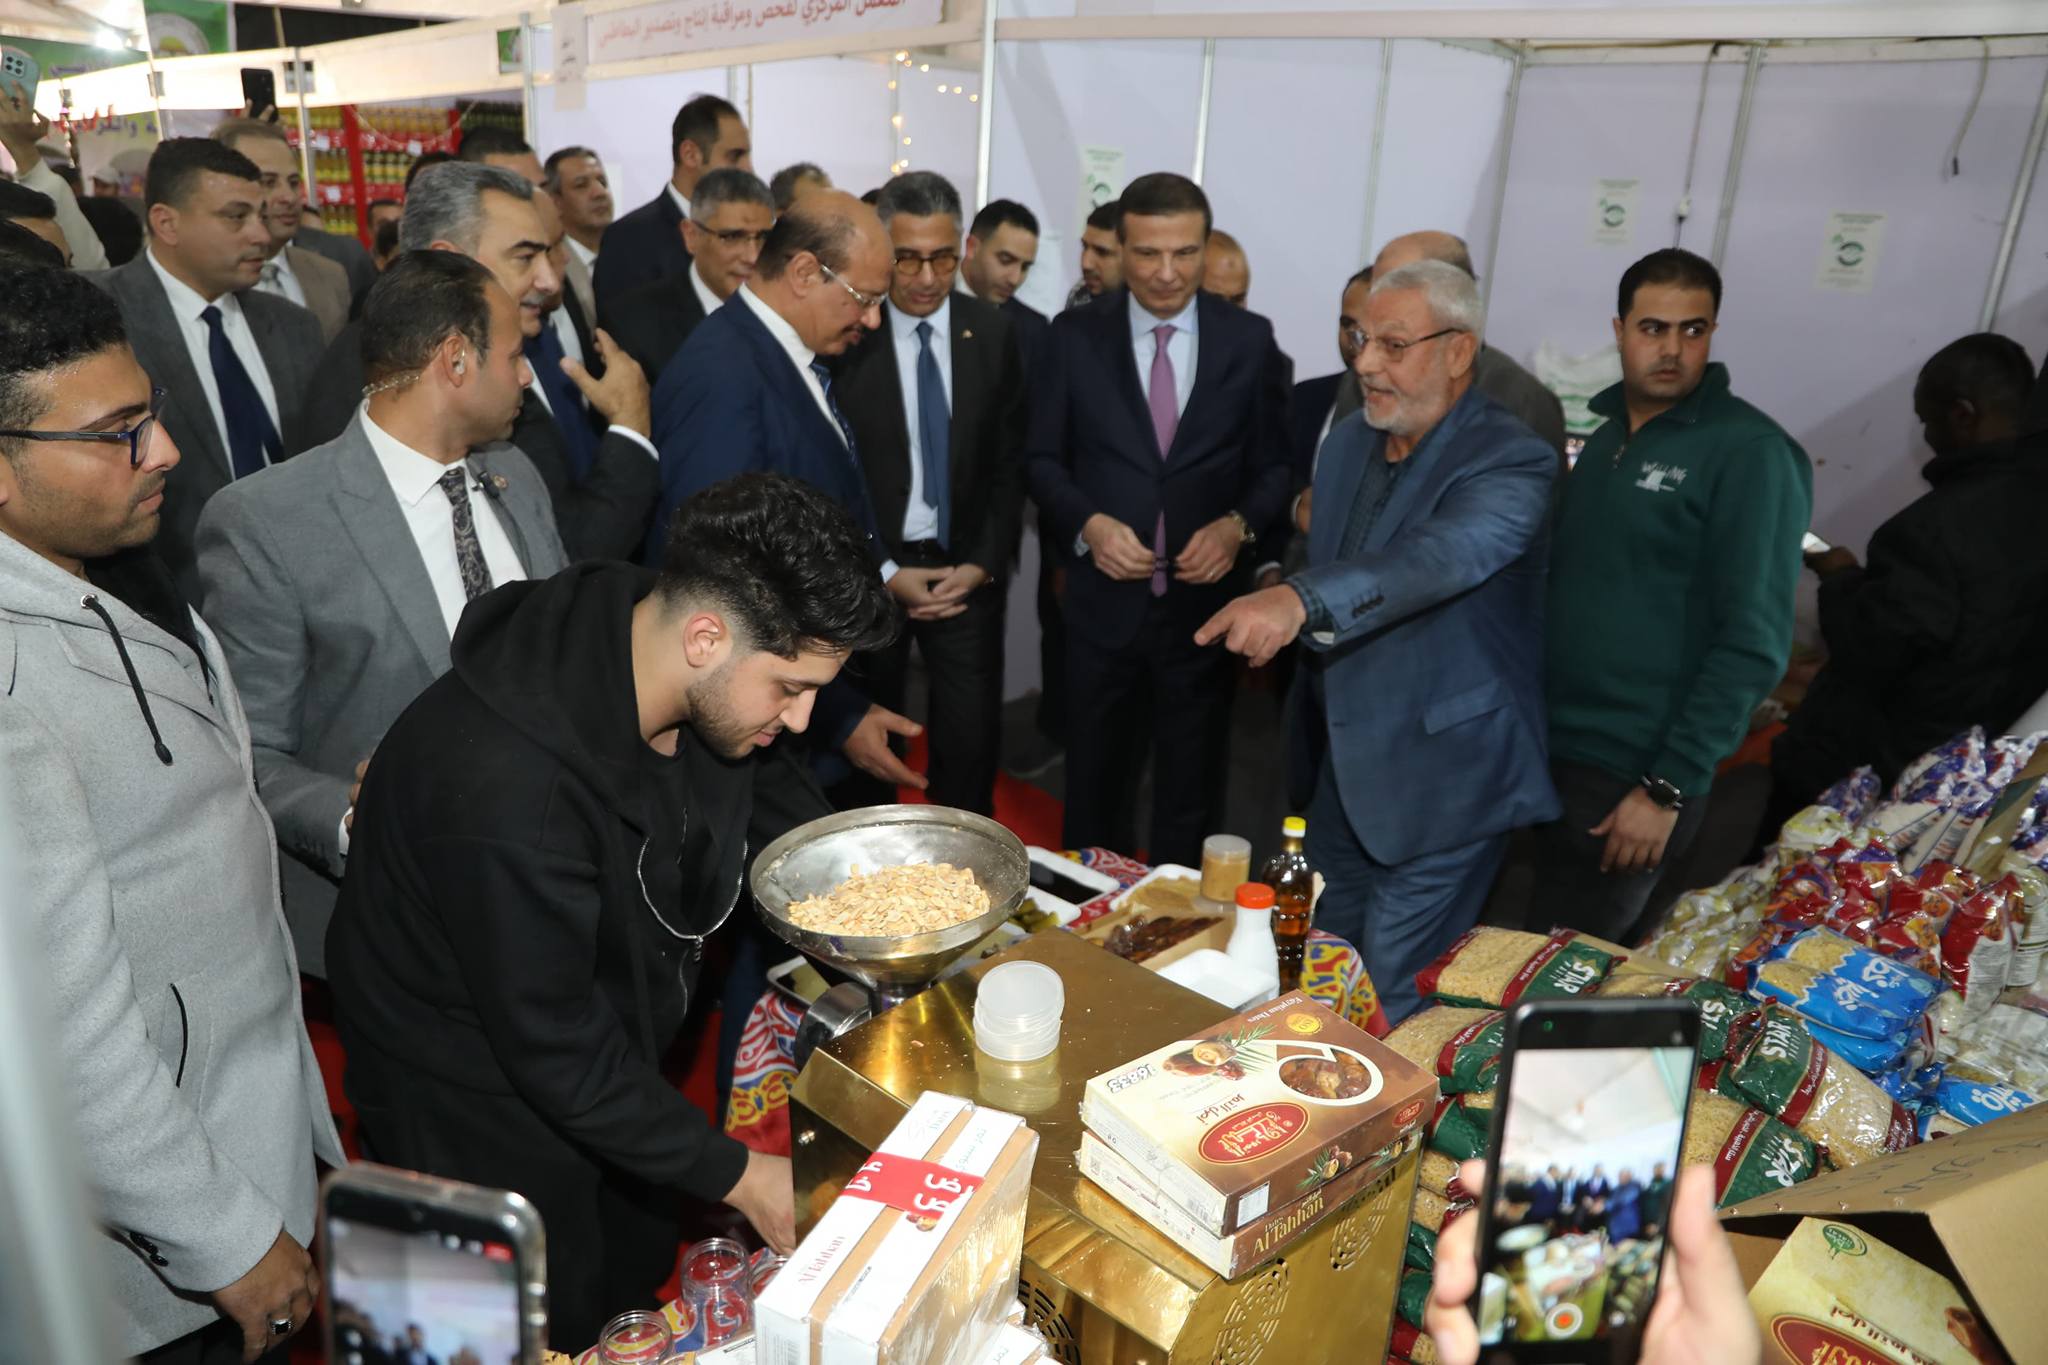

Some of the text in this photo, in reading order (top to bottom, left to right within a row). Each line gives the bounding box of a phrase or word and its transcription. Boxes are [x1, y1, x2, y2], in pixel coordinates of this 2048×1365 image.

[754, 1, 798, 28] لفحص
[1553, 961, 1596, 995] STAR
[1269, 996, 1303, 1014] Egyptian
[1760, 1019, 1791, 1060] STAR
[1106, 1063, 1156, 1094] 16833
[1196, 1104, 1221, 1126] أصل
[1220, 1093, 1247, 1115] التمر
[1764, 1138, 1806, 1188] STAR
[1252, 1195, 1324, 1257] Al Tahhan
[1829, 1304, 1867, 1329] أصل
[1866, 1327, 1908, 1354] التمر
